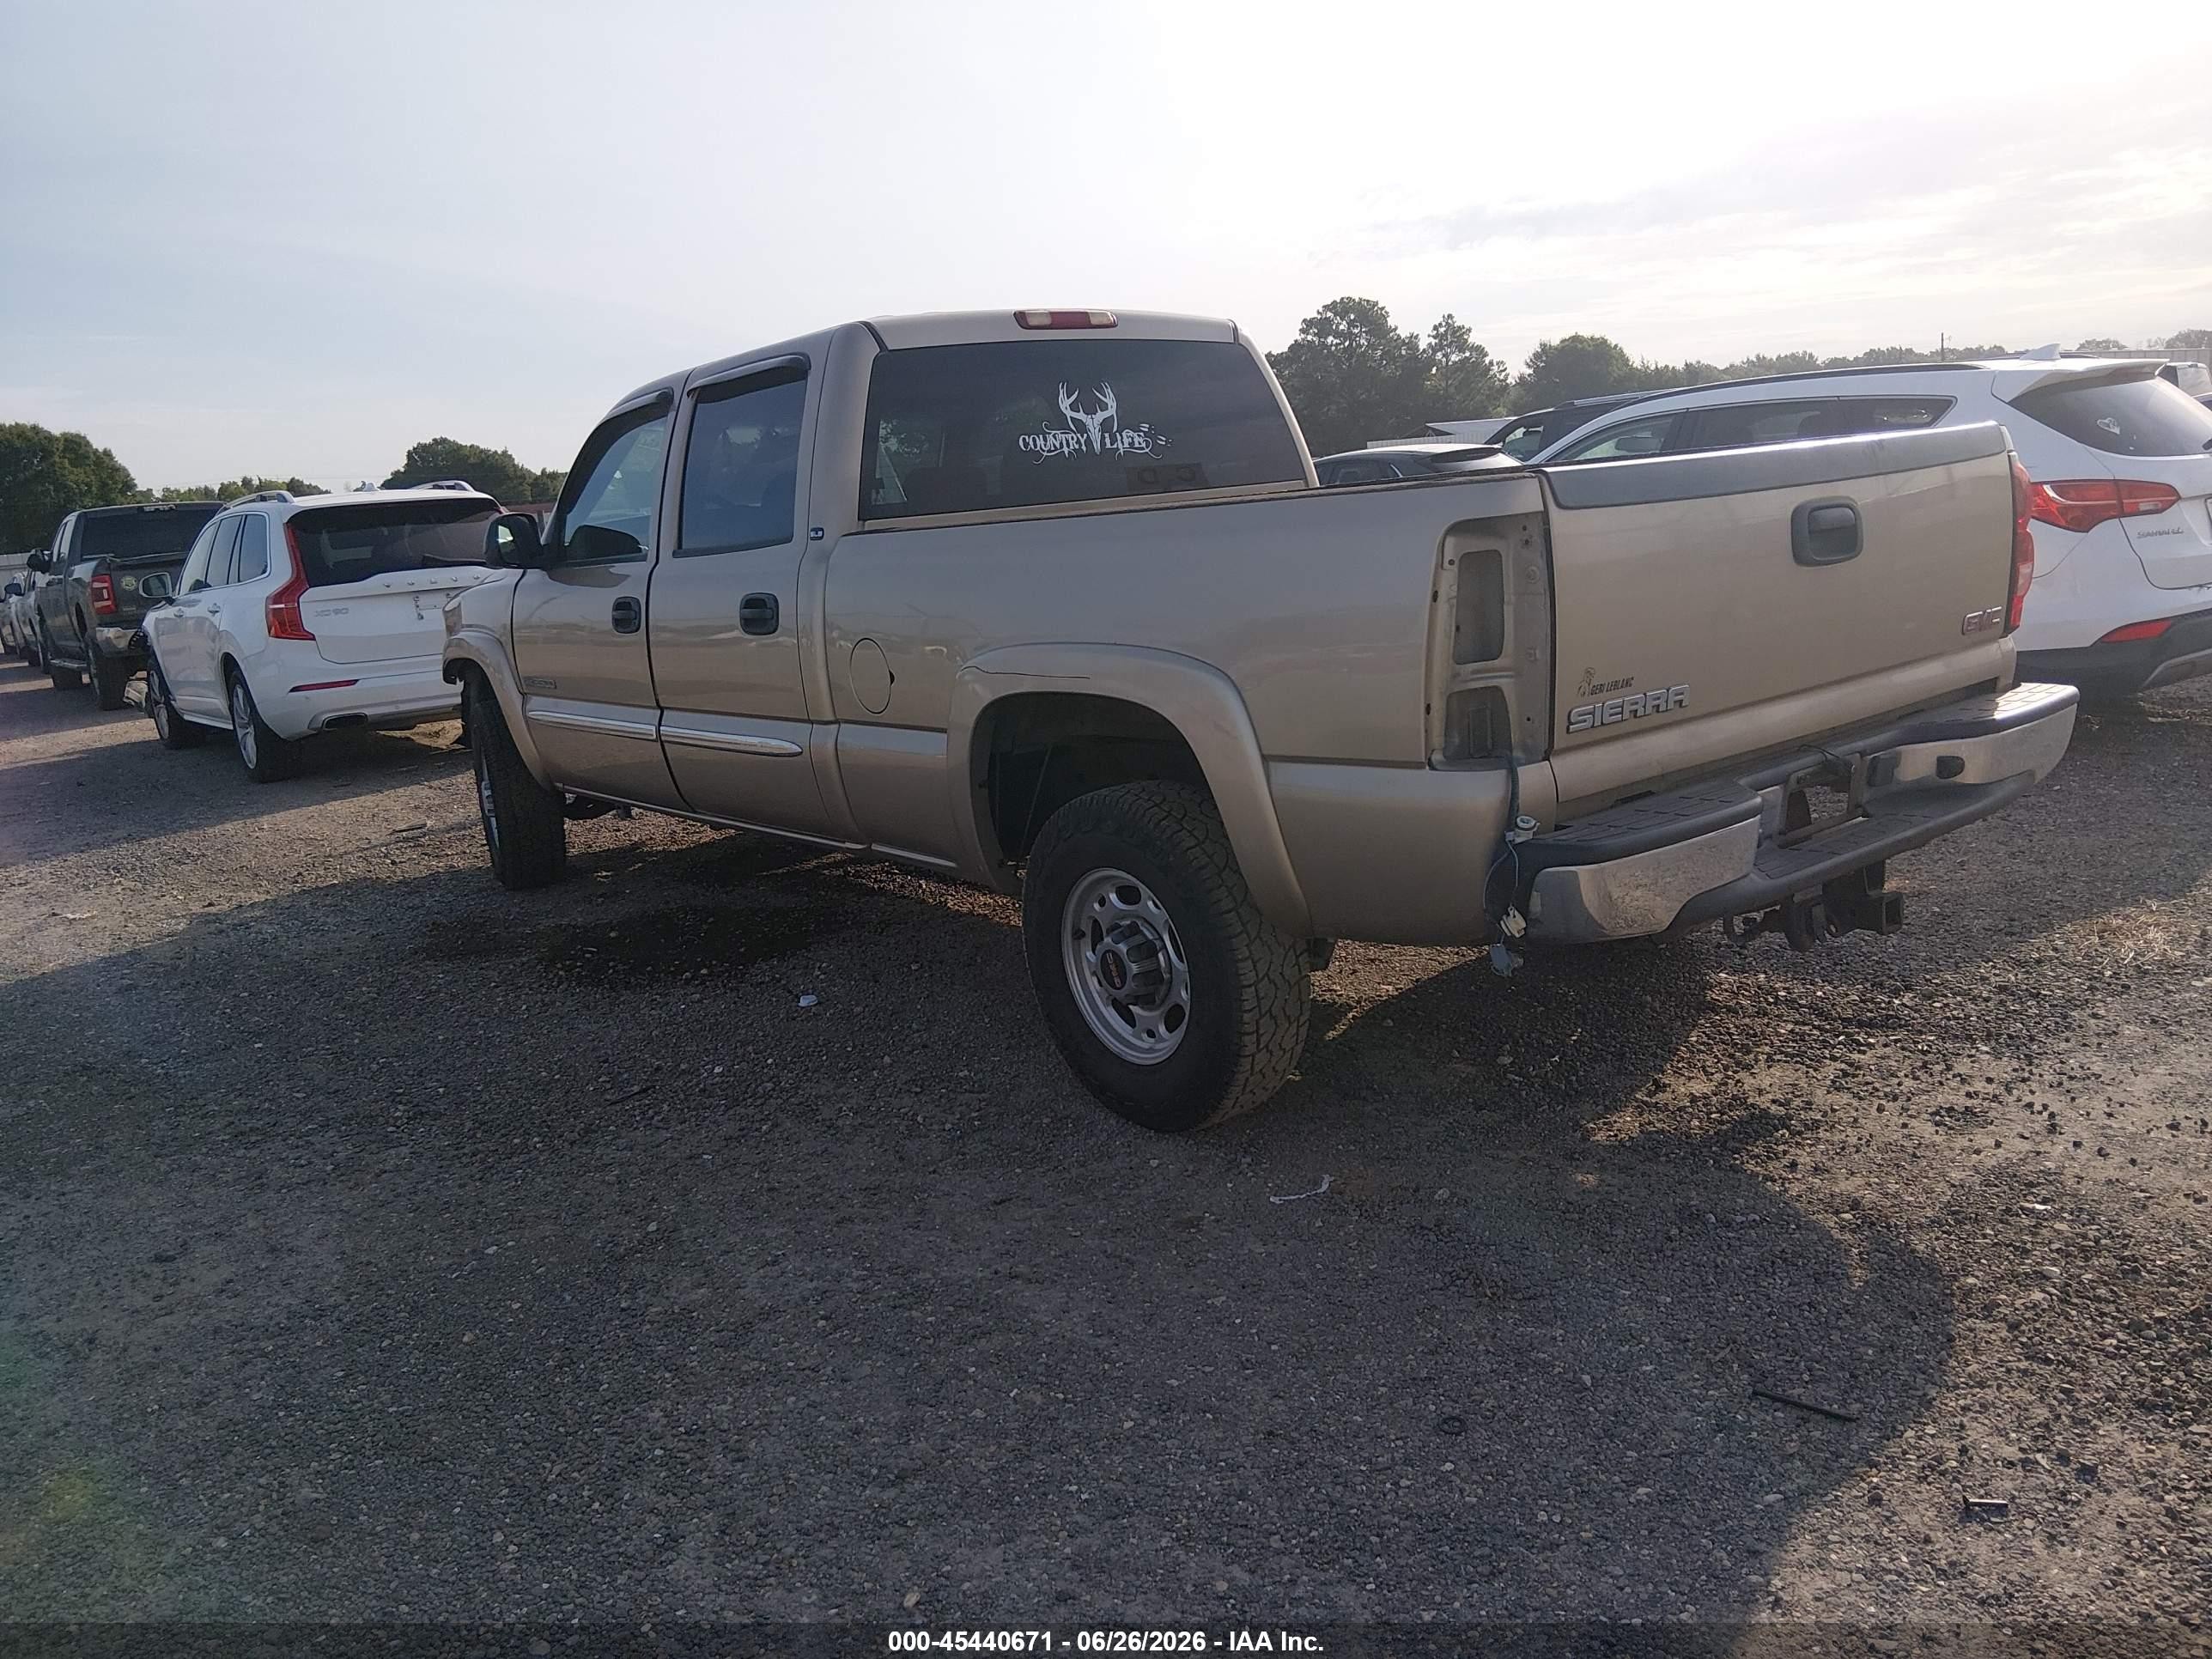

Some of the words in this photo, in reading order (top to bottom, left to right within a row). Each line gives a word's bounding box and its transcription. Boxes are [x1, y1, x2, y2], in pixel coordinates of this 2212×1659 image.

[1018, 431, 1088, 456] COUNTRY
[1104, 430, 1150, 454] LIFE
[1961, 606, 2002, 635] GMC
[1566, 684, 1690, 734] SIERRA
